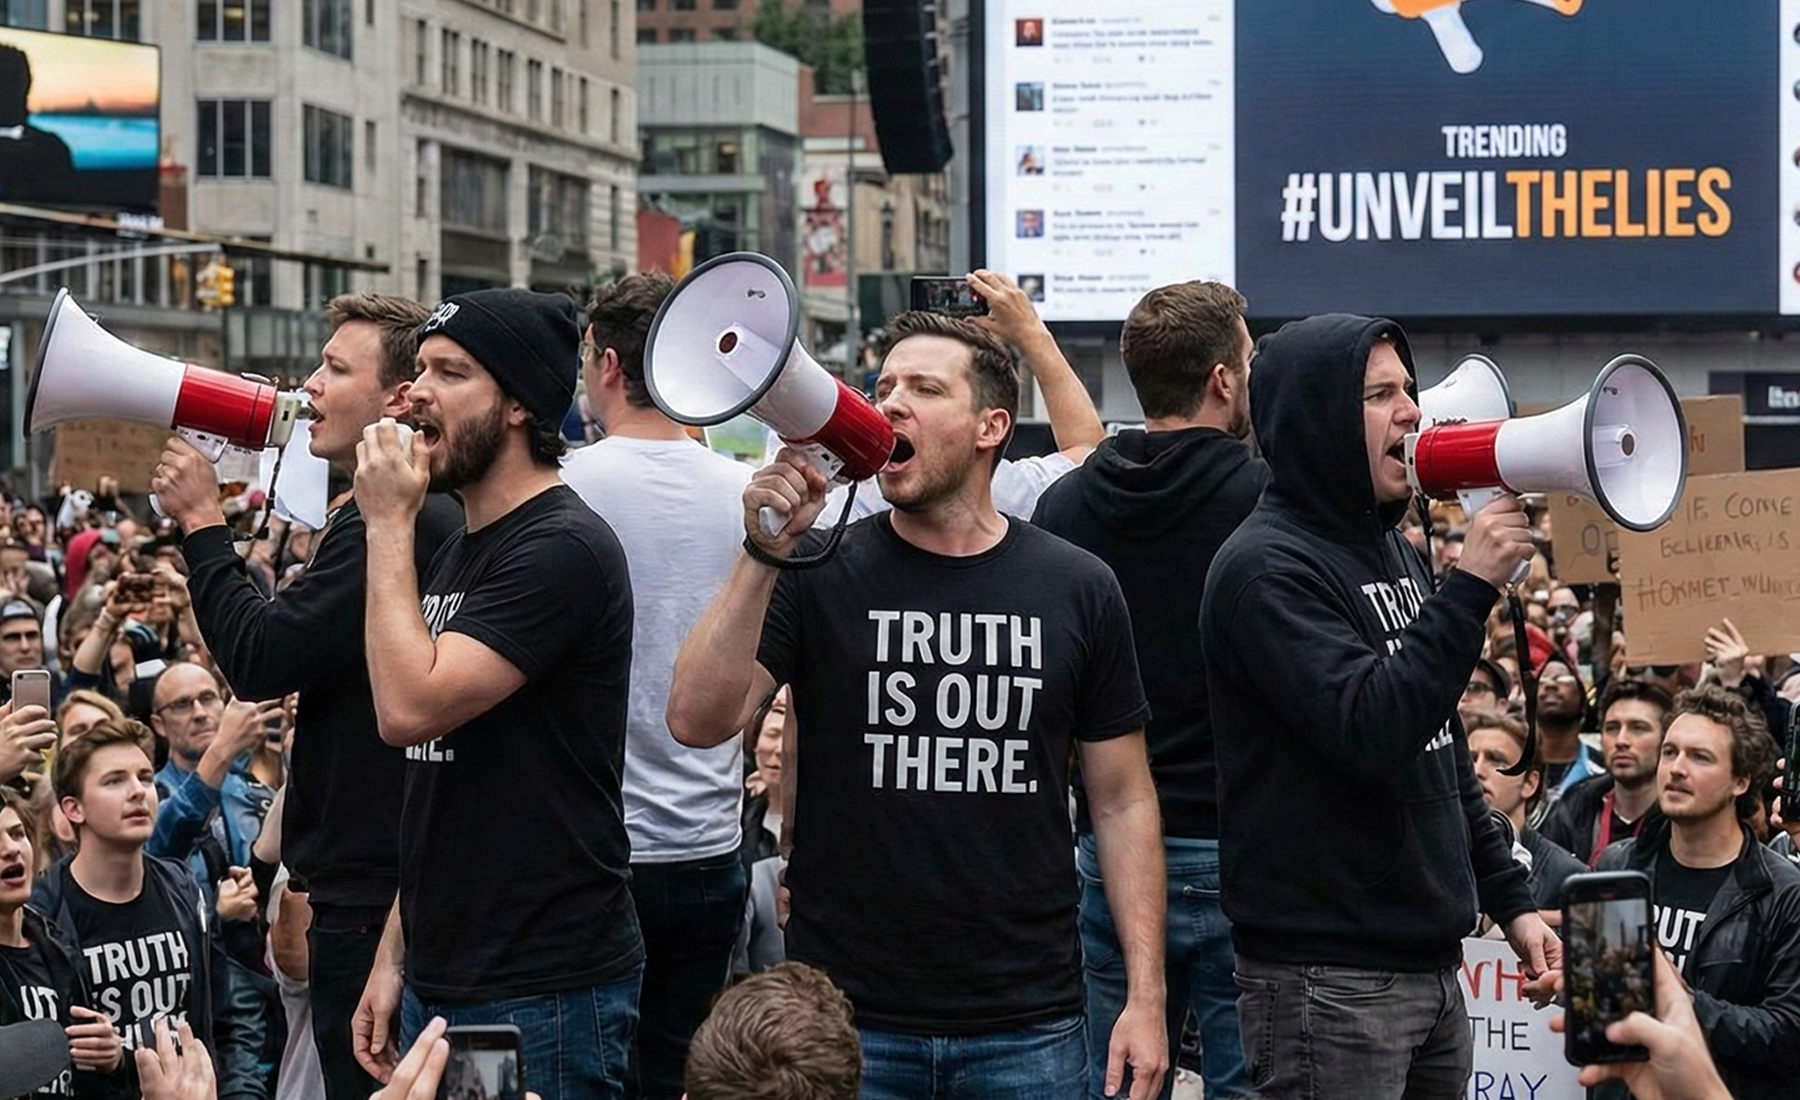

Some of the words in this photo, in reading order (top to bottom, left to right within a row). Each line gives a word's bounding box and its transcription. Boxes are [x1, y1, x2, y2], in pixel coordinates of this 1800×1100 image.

[1442, 124, 1567, 157] TRENDING
[1281, 167, 1731, 242] #UNVEILTHELIES
[868, 610, 1042, 670] TRUTH
[867, 671, 917, 726] IS
[936, 673, 1043, 731] OUT
[864, 733, 1038, 793] THERE.
[83, 931, 189, 985] TRUTH
[131, 973, 191, 1019] OUT
[1468, 1016, 1531, 1051] THE
[1468, 1071, 1548, 1100] RAY
